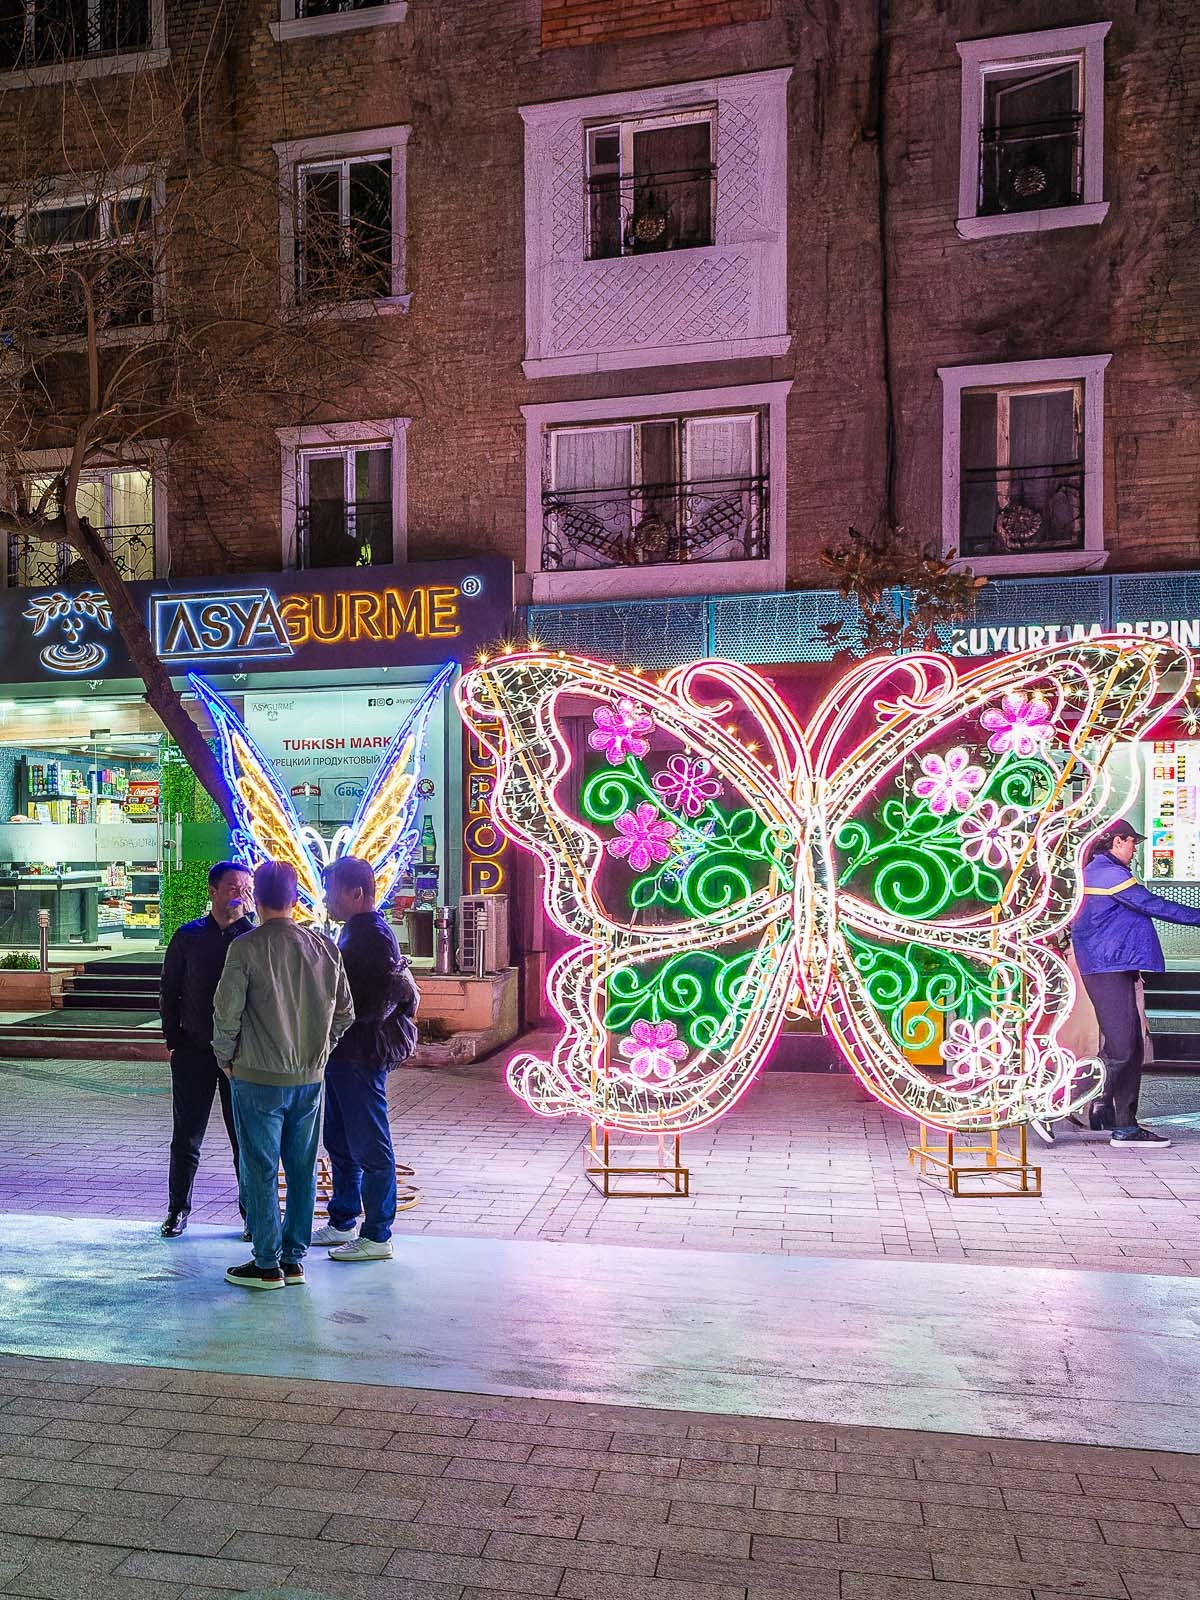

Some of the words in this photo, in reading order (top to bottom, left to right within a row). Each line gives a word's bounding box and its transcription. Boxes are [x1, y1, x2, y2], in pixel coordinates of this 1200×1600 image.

[283, 738, 346, 751] TURKISH
[349, 736, 393, 749] MARK
[270, 757, 311, 767] УРЕЦКИЙ
[312, 754, 381, 766] ПРОДУКТОВЫЙ
